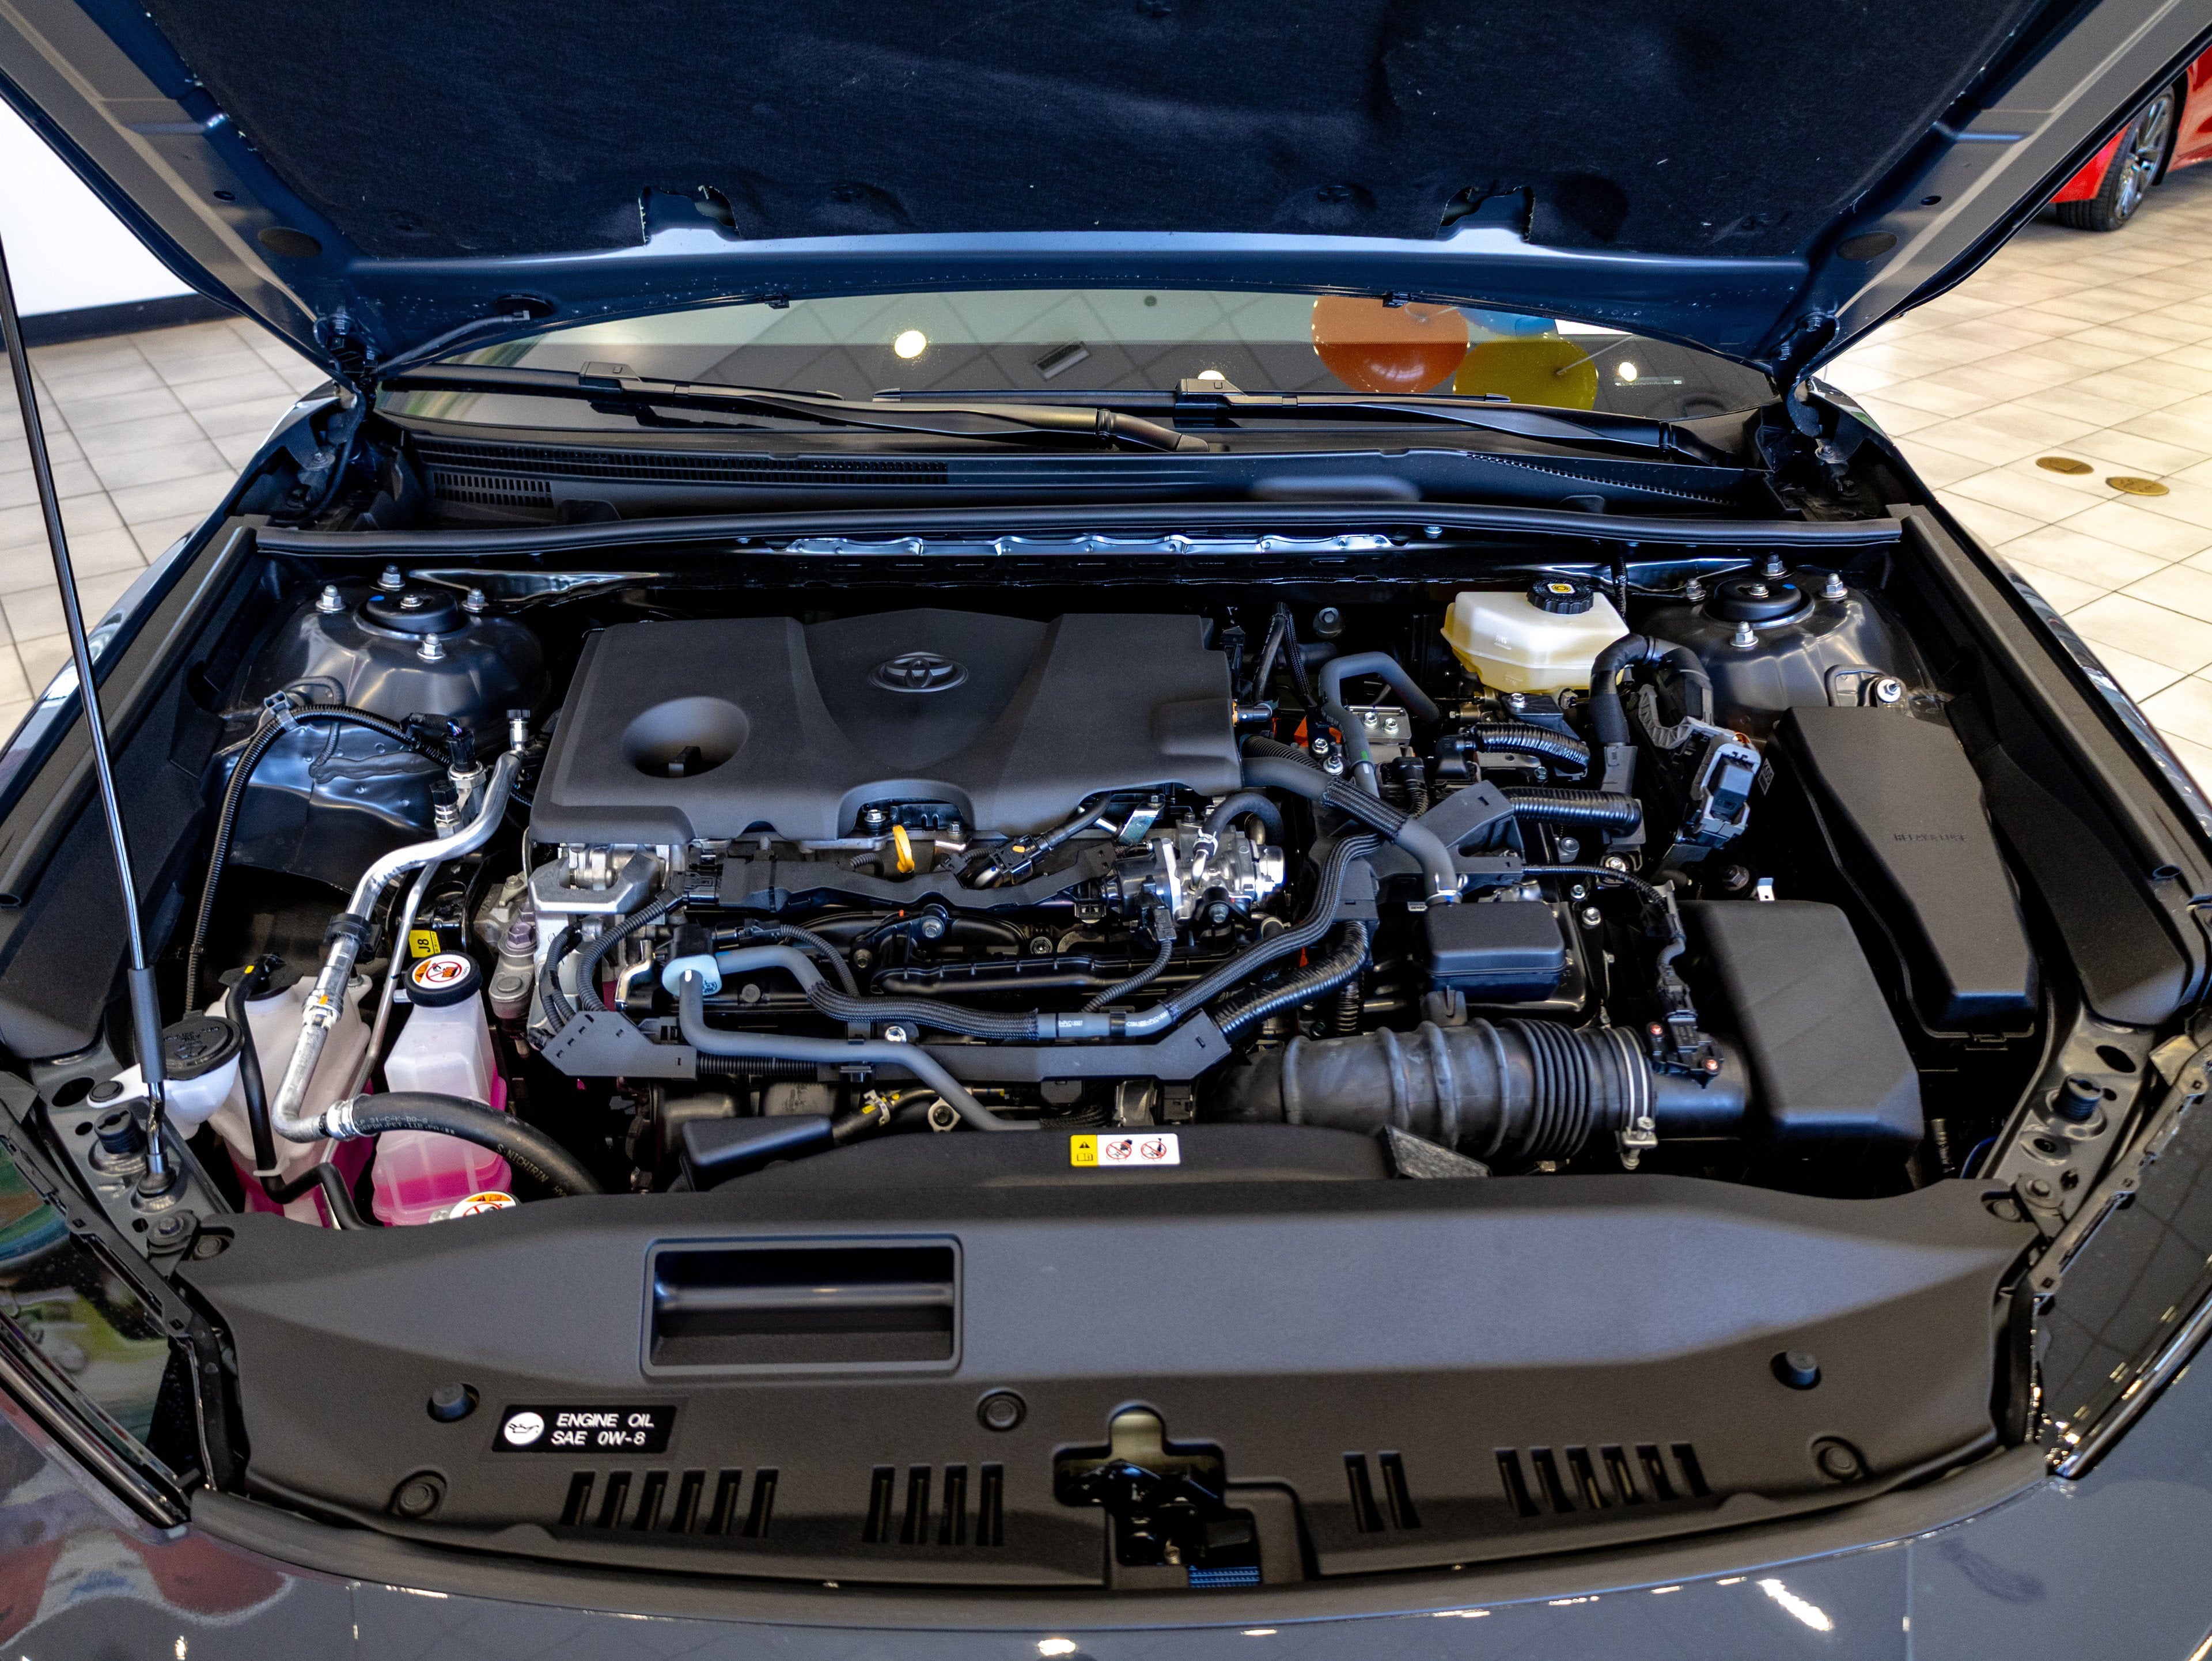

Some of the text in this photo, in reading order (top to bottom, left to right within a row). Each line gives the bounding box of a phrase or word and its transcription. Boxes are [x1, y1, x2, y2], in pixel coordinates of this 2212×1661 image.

[417, 939, 431, 952] J8
[556, 1413, 654, 1428] ENGINE OIL
[551, 1431, 646, 1447] SAE 0W-8
